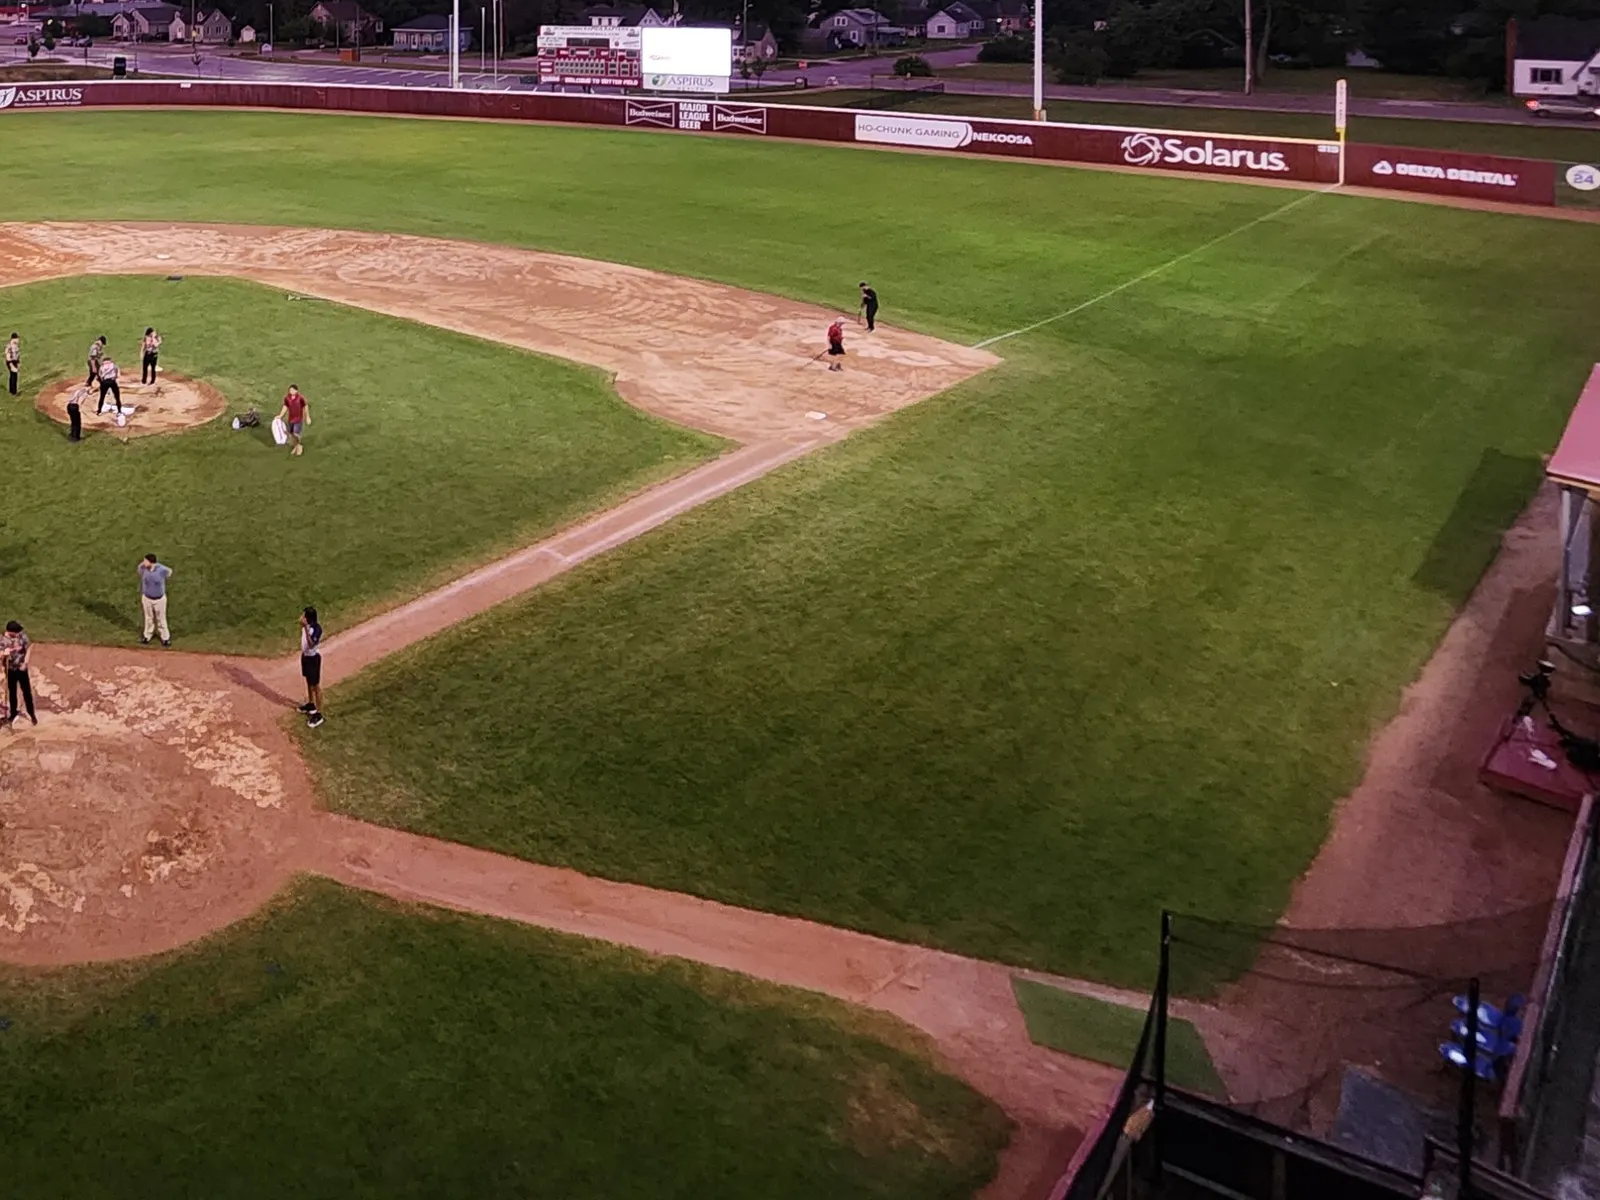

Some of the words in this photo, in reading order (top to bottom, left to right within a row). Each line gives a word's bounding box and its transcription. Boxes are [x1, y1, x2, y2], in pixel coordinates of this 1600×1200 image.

[668, 75, 714, 87] ASPIRUS
[14, 87, 82, 102] ASPIRUS
[679, 102, 708, 112] MAJOR
[679, 112, 710, 122] LEAGUE
[679, 121, 701, 130] BEER
[858, 124, 913, 136] HO-CHUNK
[915, 128, 960, 139] GAMING
[972, 131, 1033, 146] NEKOOSA
[1396, 163, 1445, 179] DELTA
[1573, 173, 1594, 184] 24
